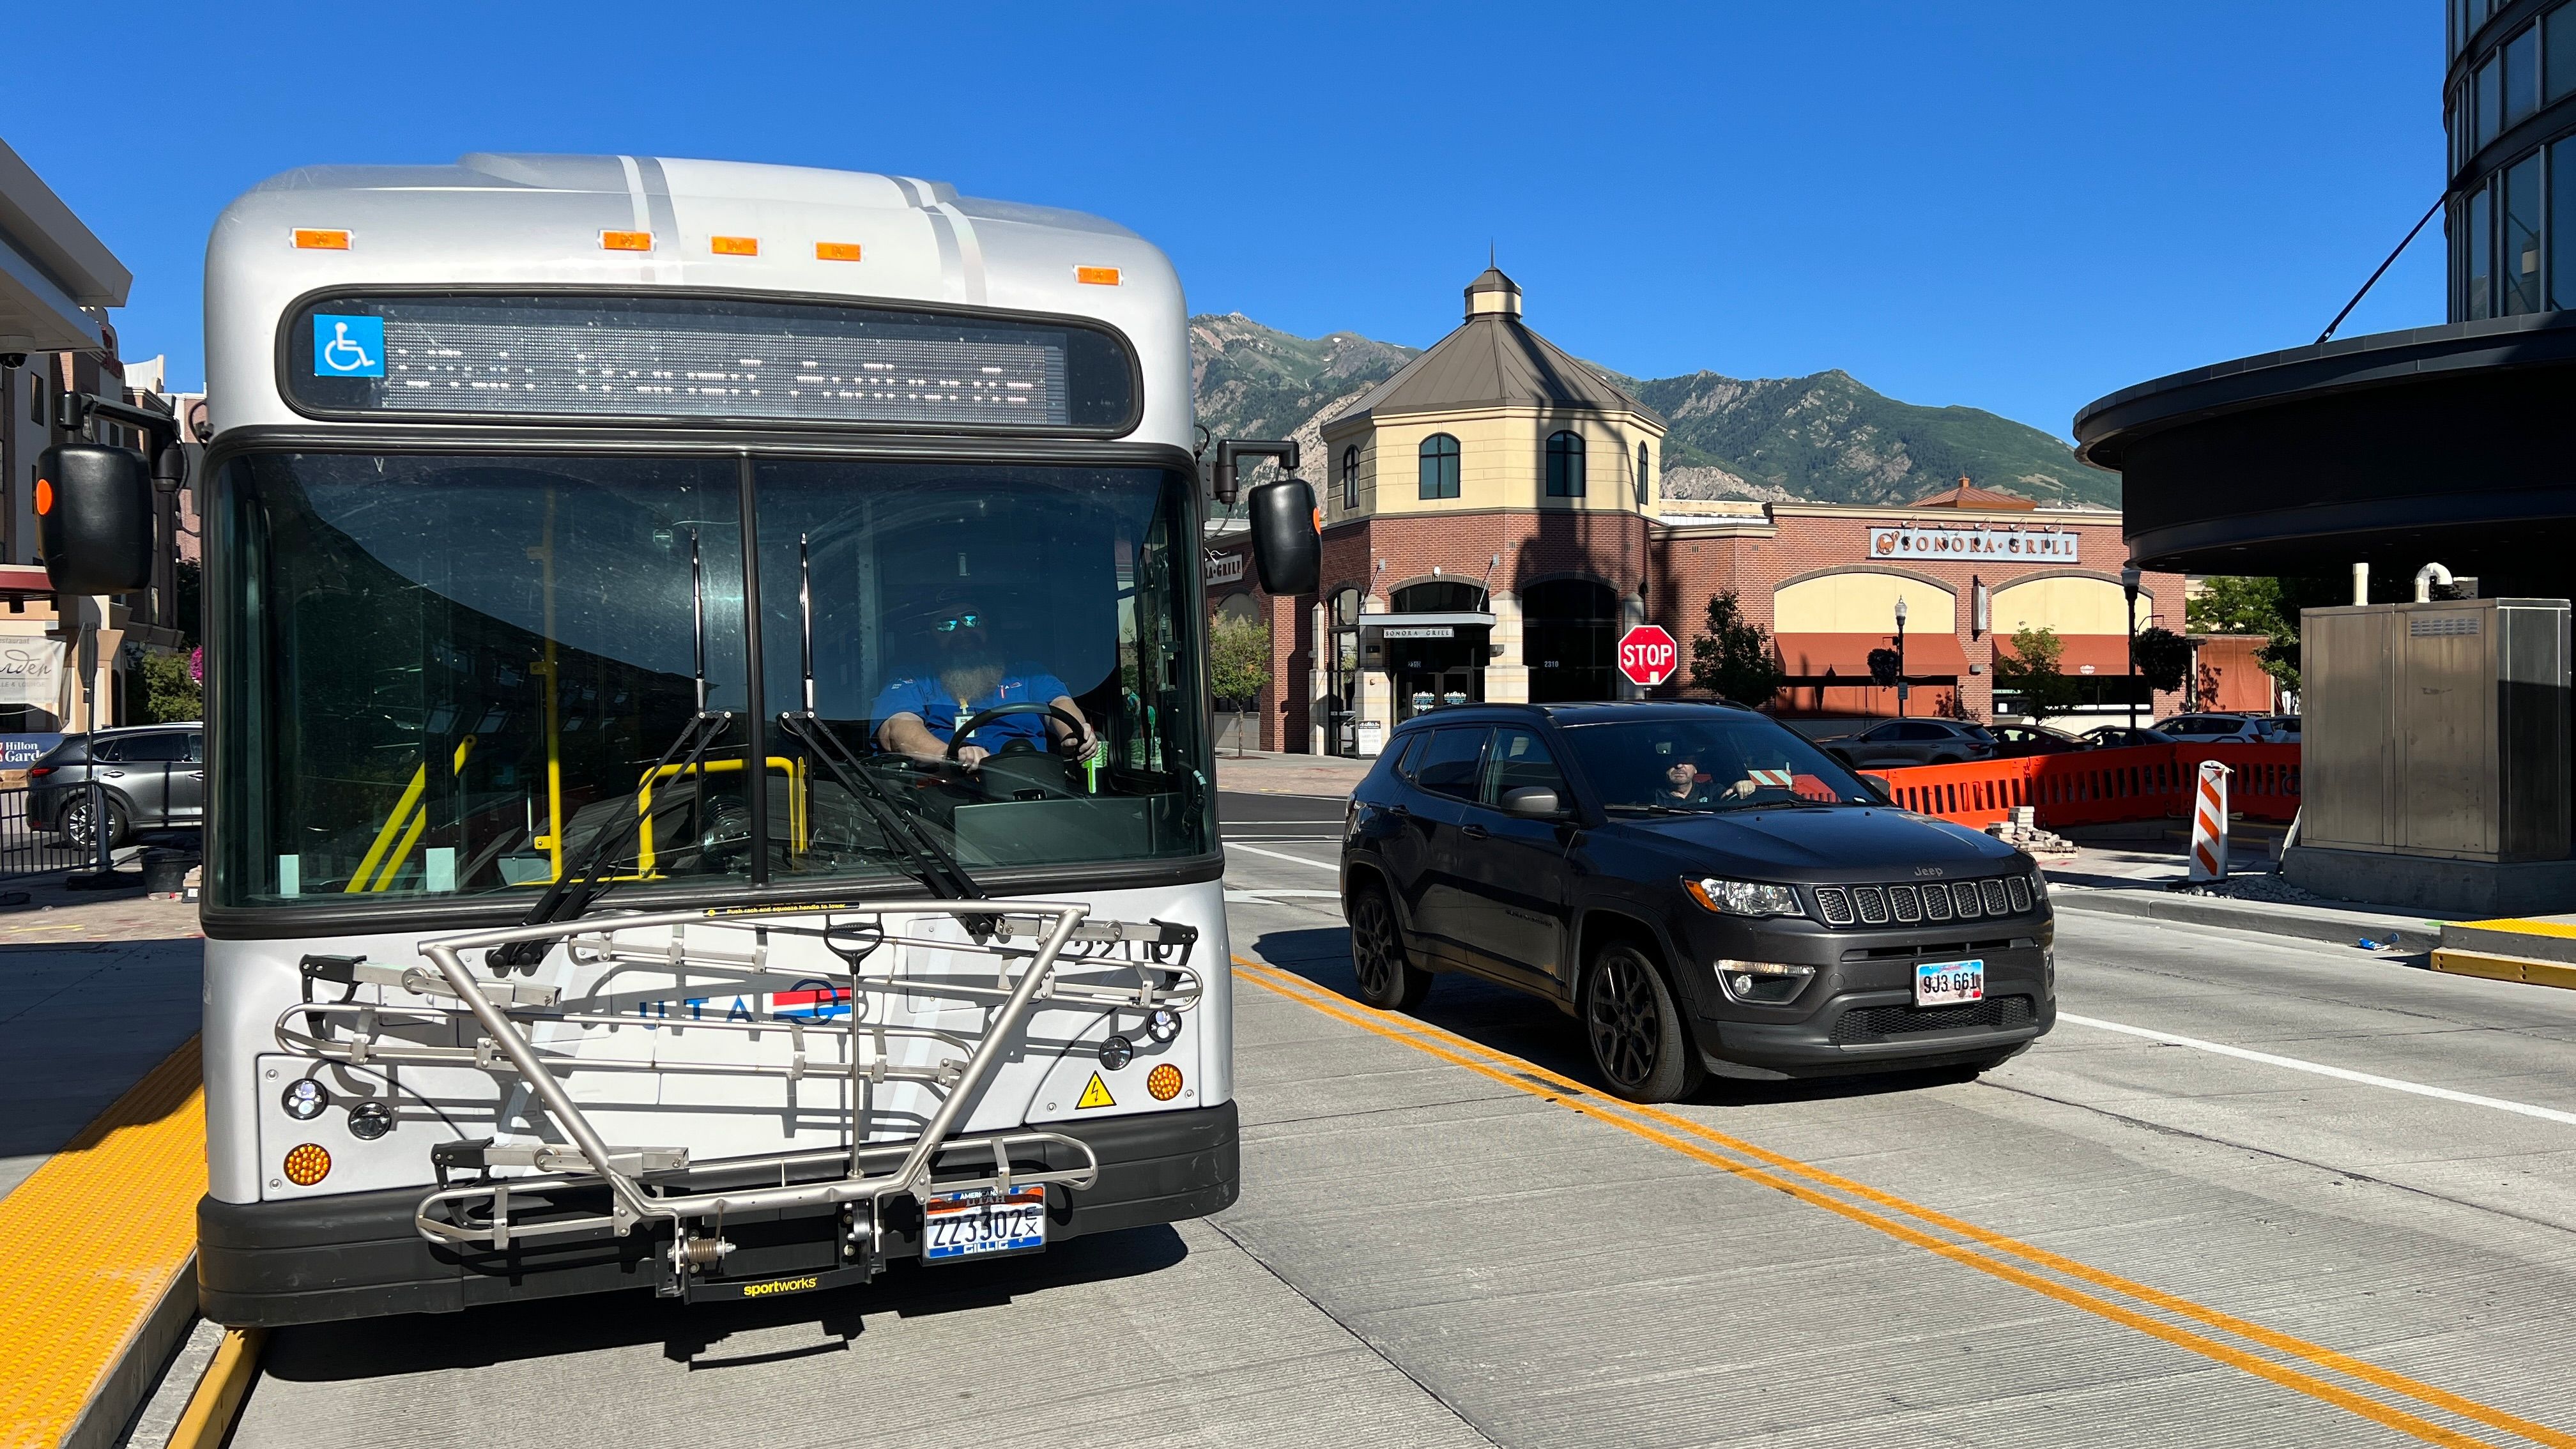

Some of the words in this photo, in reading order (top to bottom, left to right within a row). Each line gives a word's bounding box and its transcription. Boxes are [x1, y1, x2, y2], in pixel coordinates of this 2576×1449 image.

[1903, 535, 1995, 553] SONORA
[2009, 537, 2073, 555] GRILL
[1217, 561, 1240, 577] GRILL
[1623, 644, 1673, 666] STOP
[5, 742, 38, 750] Hilton
[1914, 866, 1943, 877] Jeep
[1924, 974, 1948, 993] 9J3
[1954, 972, 1977, 990] 661
[640, 994, 754, 1030] UTA
[966, 1195, 1006, 1207] UTAH
[933, 1209, 1022, 1247] 223302
[963, 1240, 1009, 1254] GILLIG
[744, 1278, 817, 1297] sportworks
